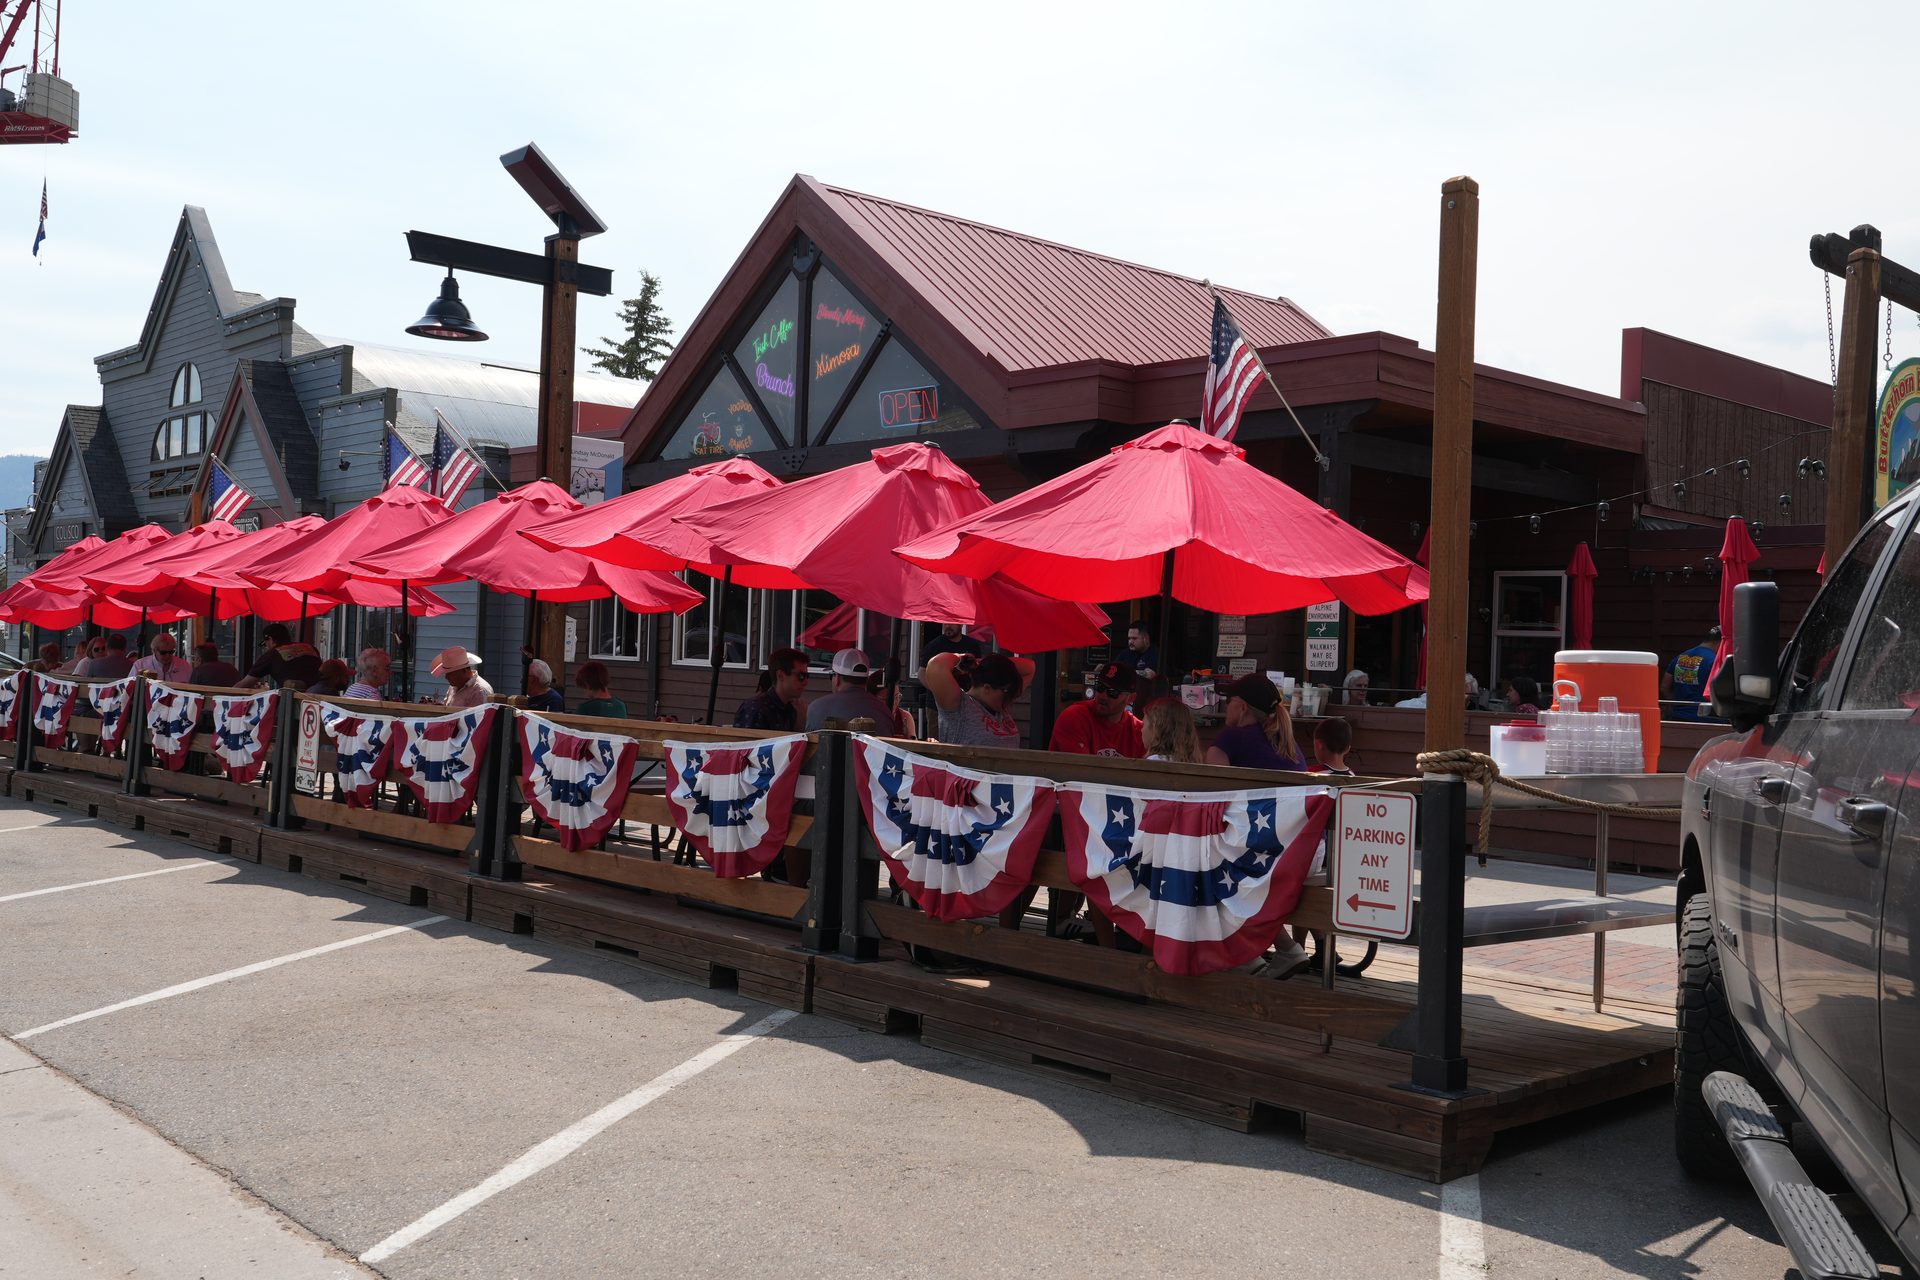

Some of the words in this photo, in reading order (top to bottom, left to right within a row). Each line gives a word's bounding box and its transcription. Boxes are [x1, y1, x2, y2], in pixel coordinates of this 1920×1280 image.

[753, 333, 769, 362] Irish
[769, 319, 793, 349] Coffee
[816, 344, 860, 380] Mimosa
[756, 363, 794, 398] Brunch
[881, 390, 937, 425] OPEN
[1879, 373, 1914, 474] Butterhorn
[304, 740, 313, 748] ANY
[1366, 804, 1387, 818] NO
[1345, 827, 1406, 846] PARKING
[1360, 854, 1389, 868] ANY
[1358, 877, 1390, 892] TIME
